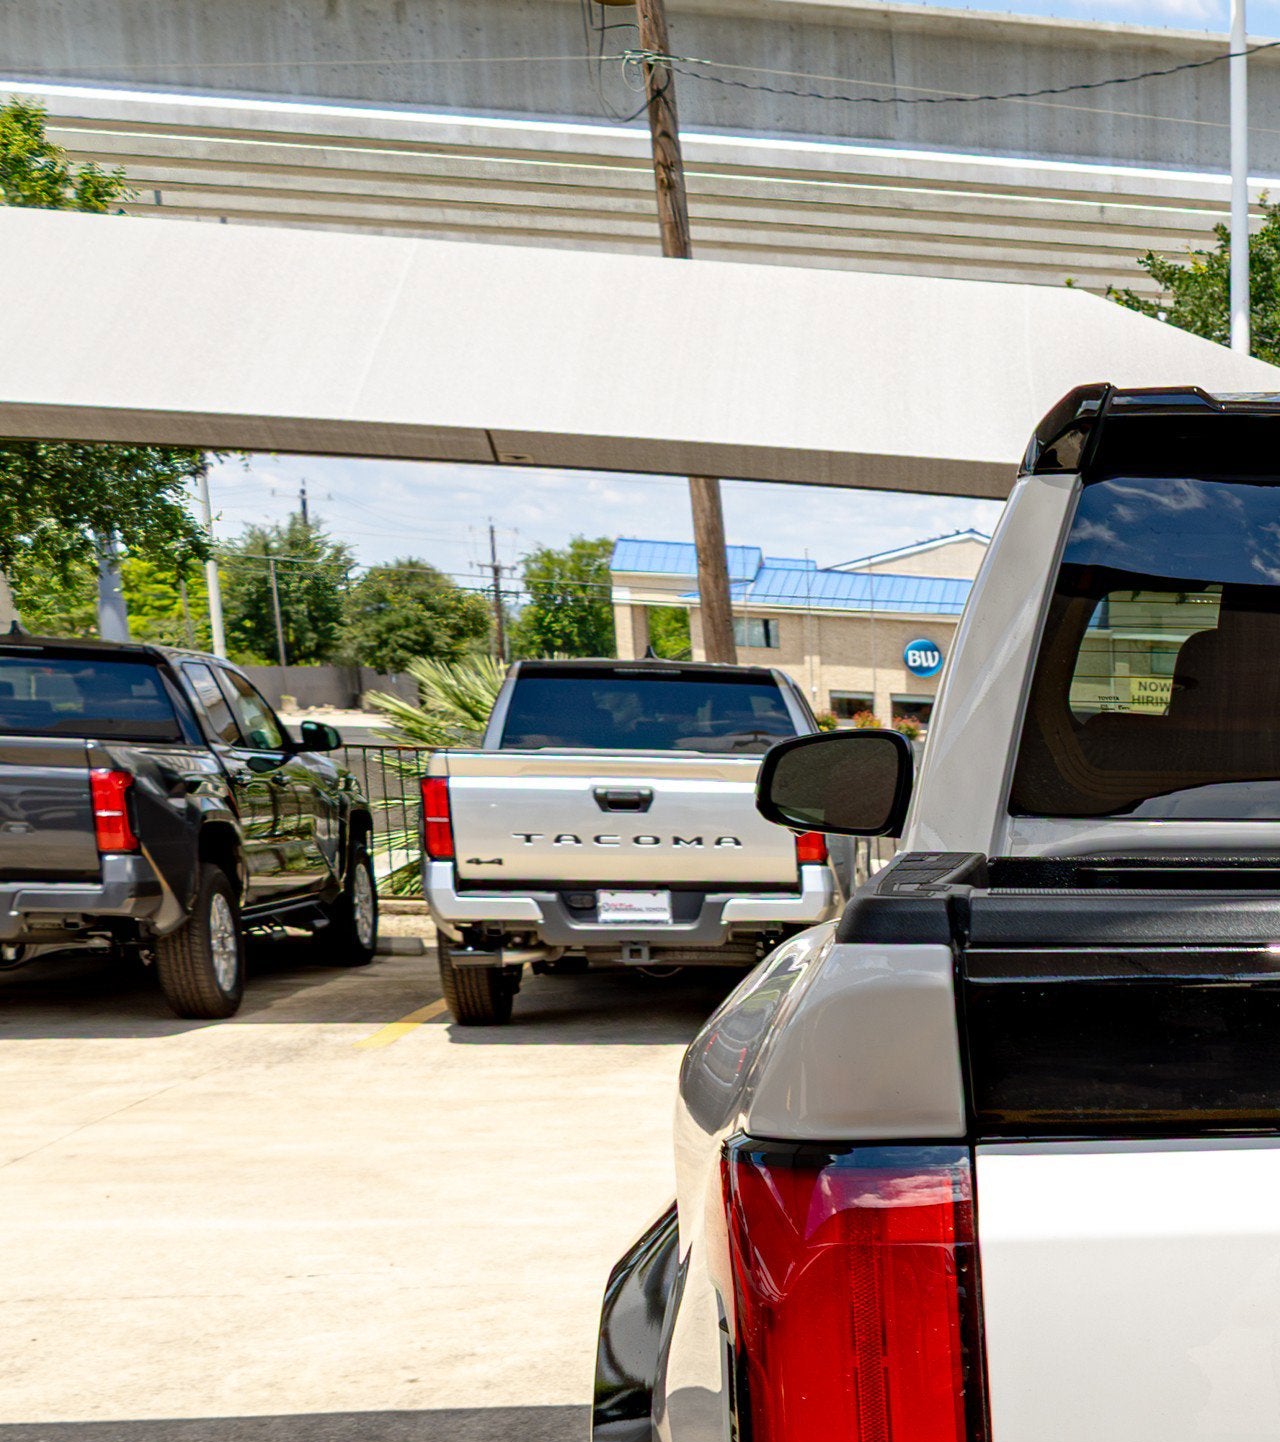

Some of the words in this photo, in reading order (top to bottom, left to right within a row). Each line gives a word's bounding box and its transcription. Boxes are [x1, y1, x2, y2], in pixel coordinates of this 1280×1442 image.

[908, 650, 940, 668] BW
[1138, 682, 1172, 692] NOW
[1131, 695, 1169, 706] HIRIN
[512, 833, 744, 848] TACOMA
